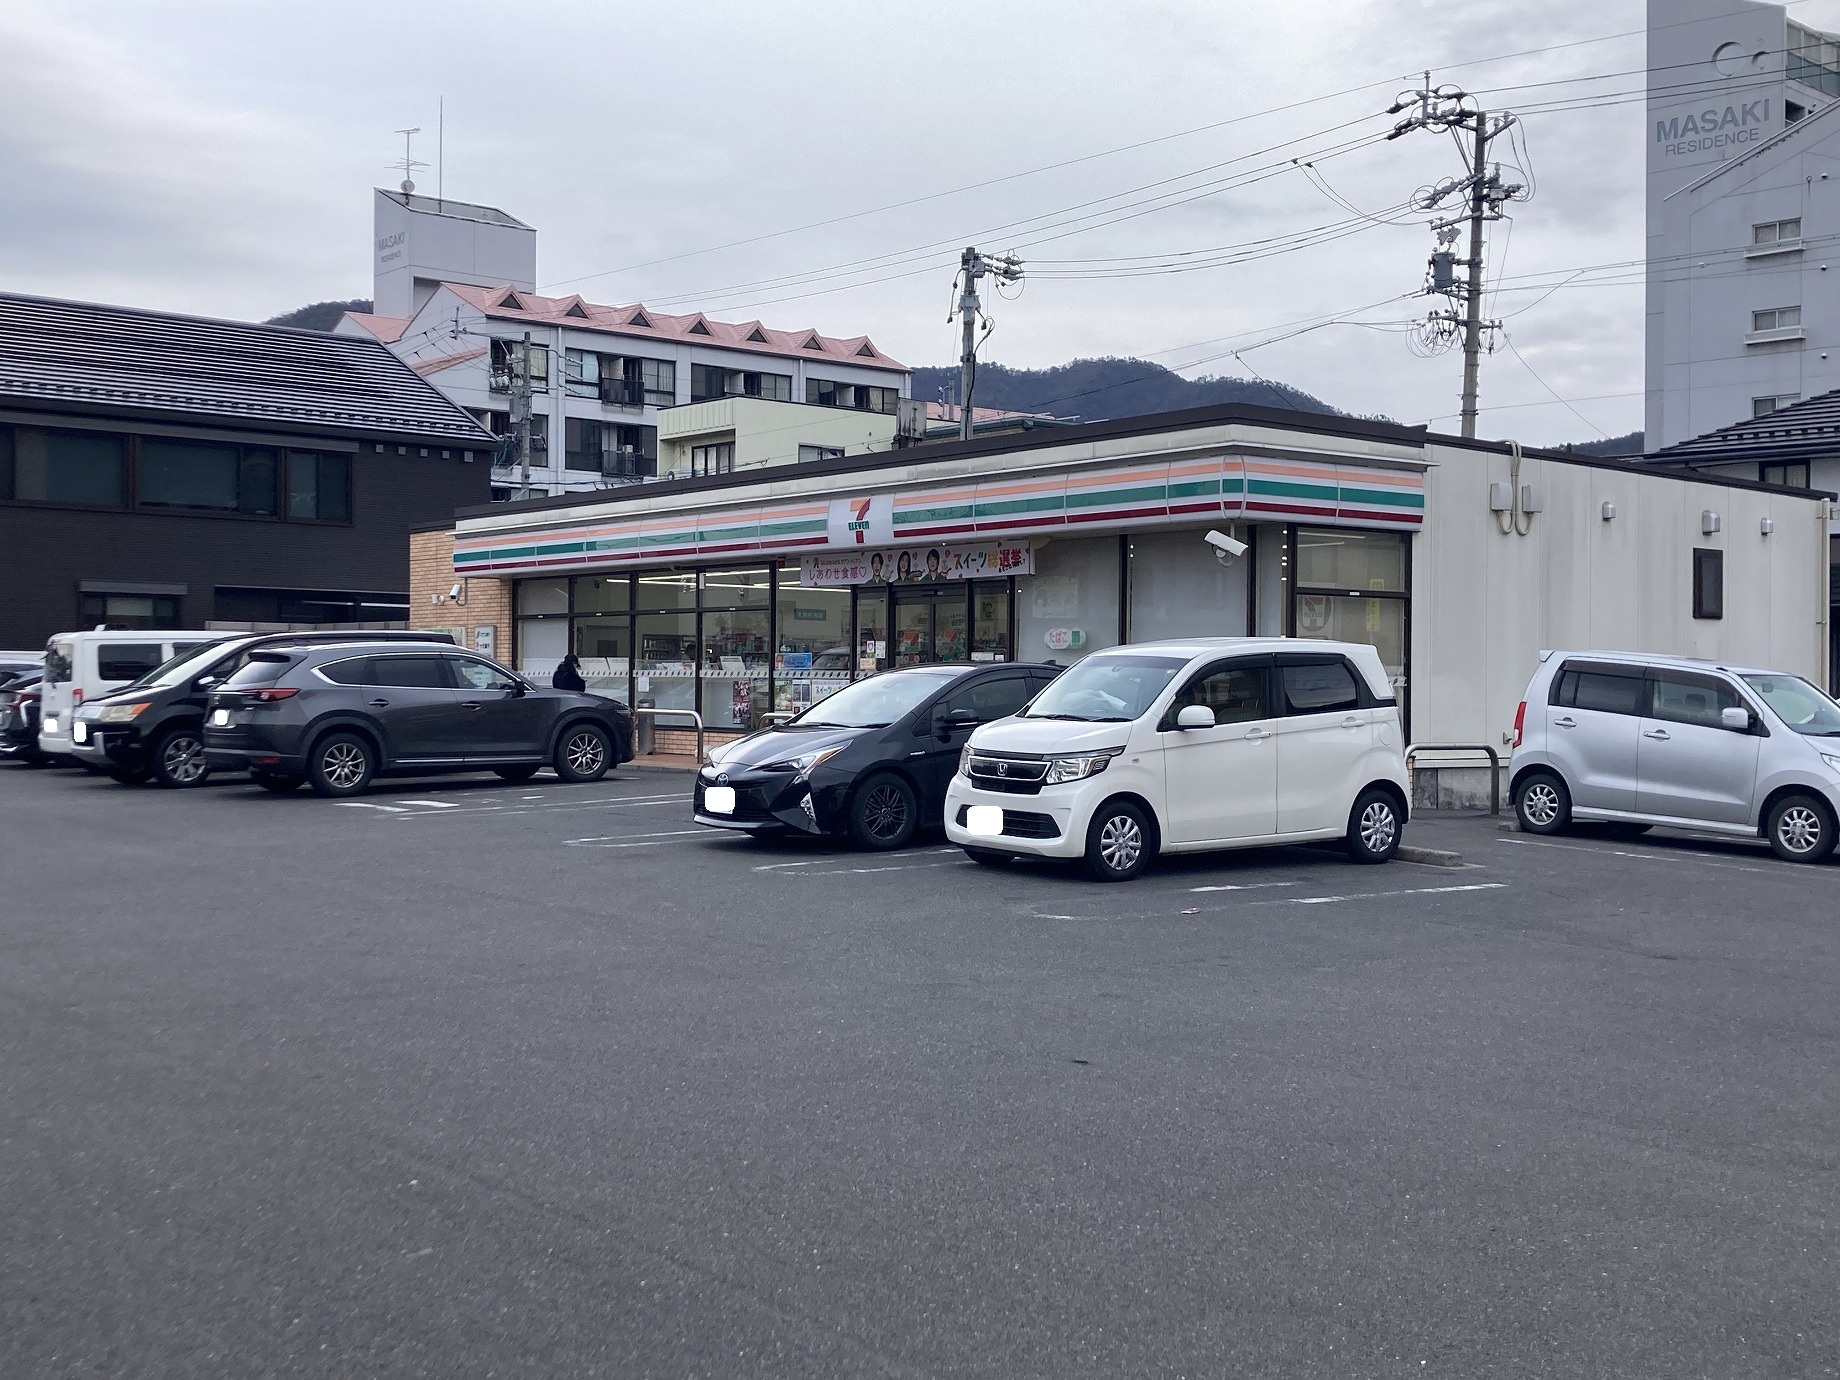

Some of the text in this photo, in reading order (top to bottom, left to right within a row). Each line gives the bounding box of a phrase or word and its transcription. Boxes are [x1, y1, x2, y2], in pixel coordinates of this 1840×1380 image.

[1656, 99, 1770, 143] MASAKI
[1665, 128, 1760, 157] RESIDENCE
[378, 232, 405, 251] MASAKI
[850, 498, 871, 544] 7
